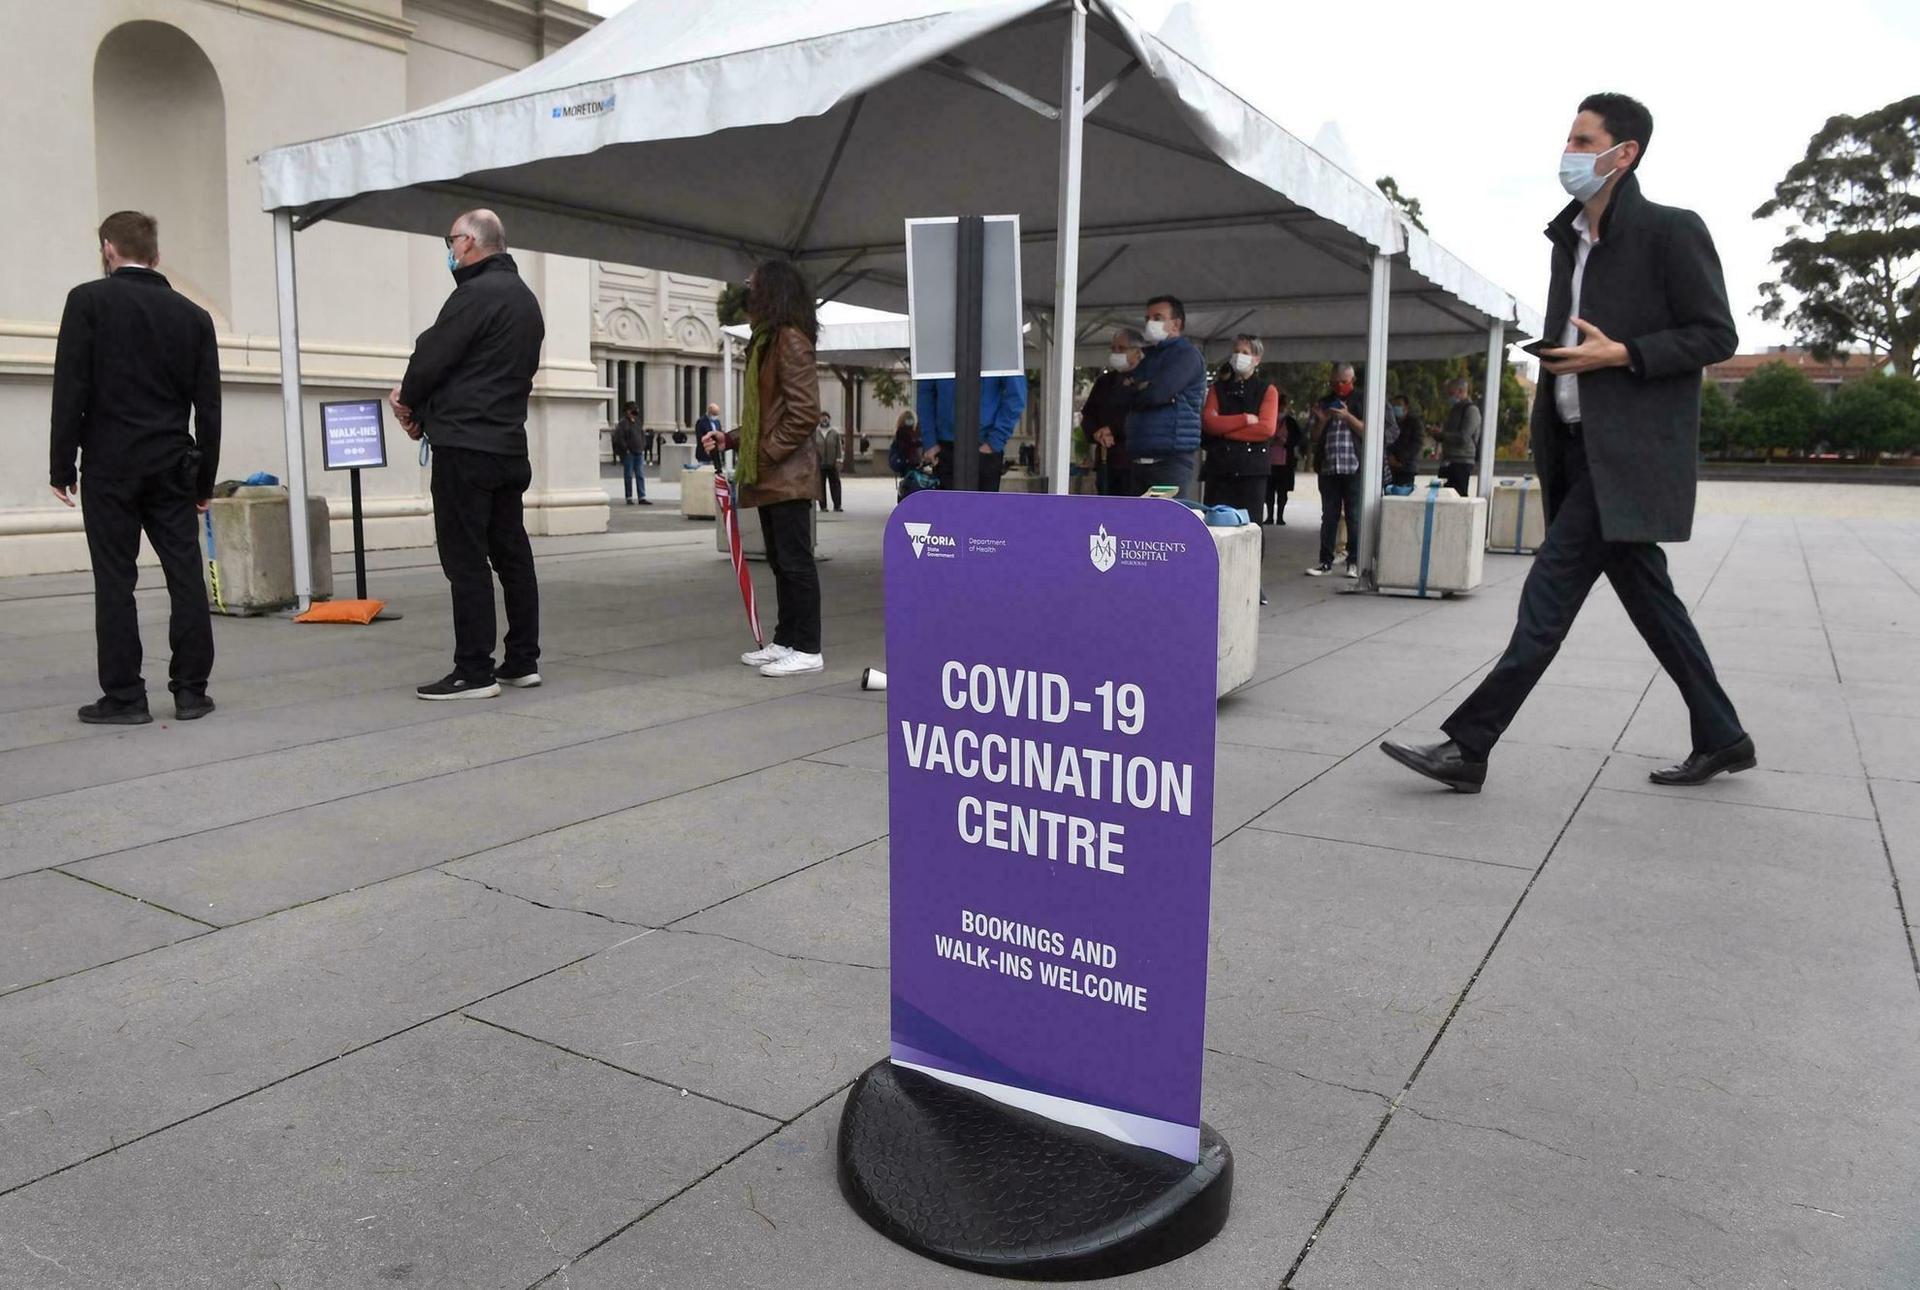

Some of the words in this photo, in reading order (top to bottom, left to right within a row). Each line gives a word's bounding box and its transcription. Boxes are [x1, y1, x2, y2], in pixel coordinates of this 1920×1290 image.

[911, 535, 956, 546] VICTORIA
[968, 538, 1006, 547] Department
[1120, 540, 1132, 549] ST
[1134, 541, 1186, 553] VINCENT'S
[1121, 550, 1168, 562] HOSPITAL
[941, 660, 1145, 735] COVID-19
[901, 720, 1192, 816] VACCINATION
[957, 796, 1125, 875] CENTRE
[961, 910, 1065, 956] BOOKINGS
[1070, 938, 1117, 969] AND
[935, 934, 1033, 981] WALK-INS
[1039, 961, 1148, 1012] WELCOME
